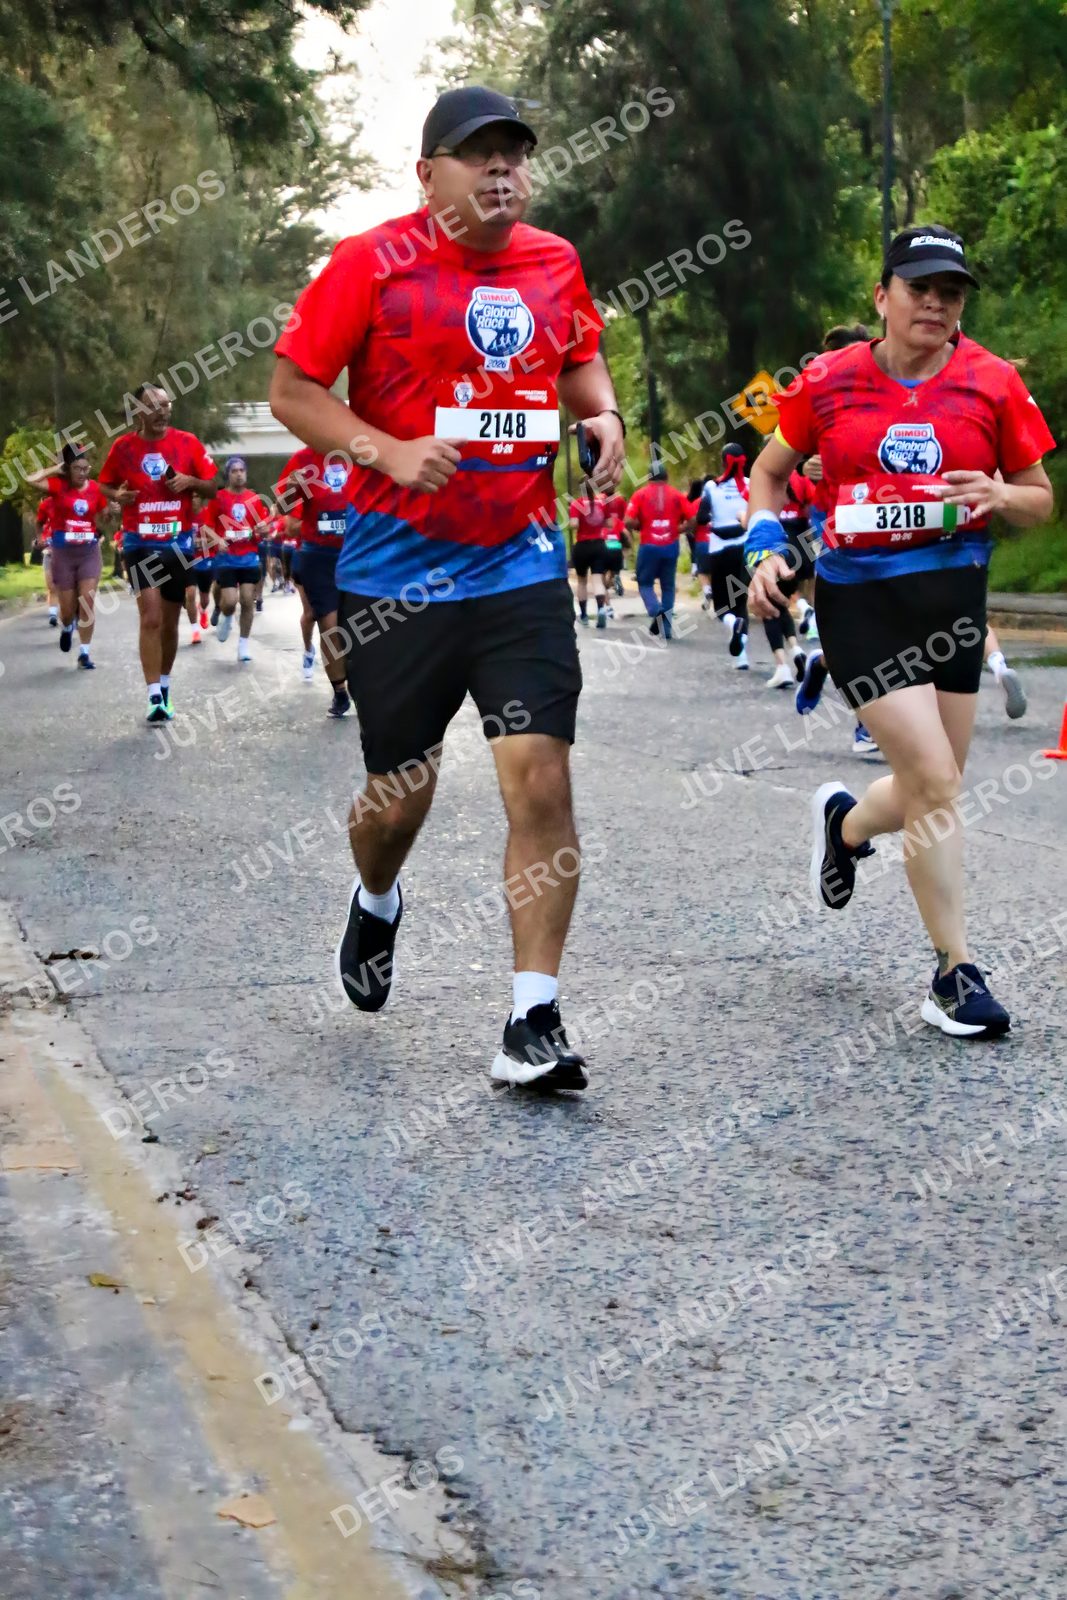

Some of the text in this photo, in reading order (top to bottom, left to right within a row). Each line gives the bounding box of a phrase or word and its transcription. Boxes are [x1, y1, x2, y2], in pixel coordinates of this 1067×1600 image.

[483, 305, 517, 319] Global
[477, 316, 505, 328] Race
[479, 412, 526, 438] 2148
[894, 440, 928, 452] Global
[888, 450, 914, 460] Race
[139, 500, 182, 513] SANTIAGO
[876, 504, 926, 529] 3218
